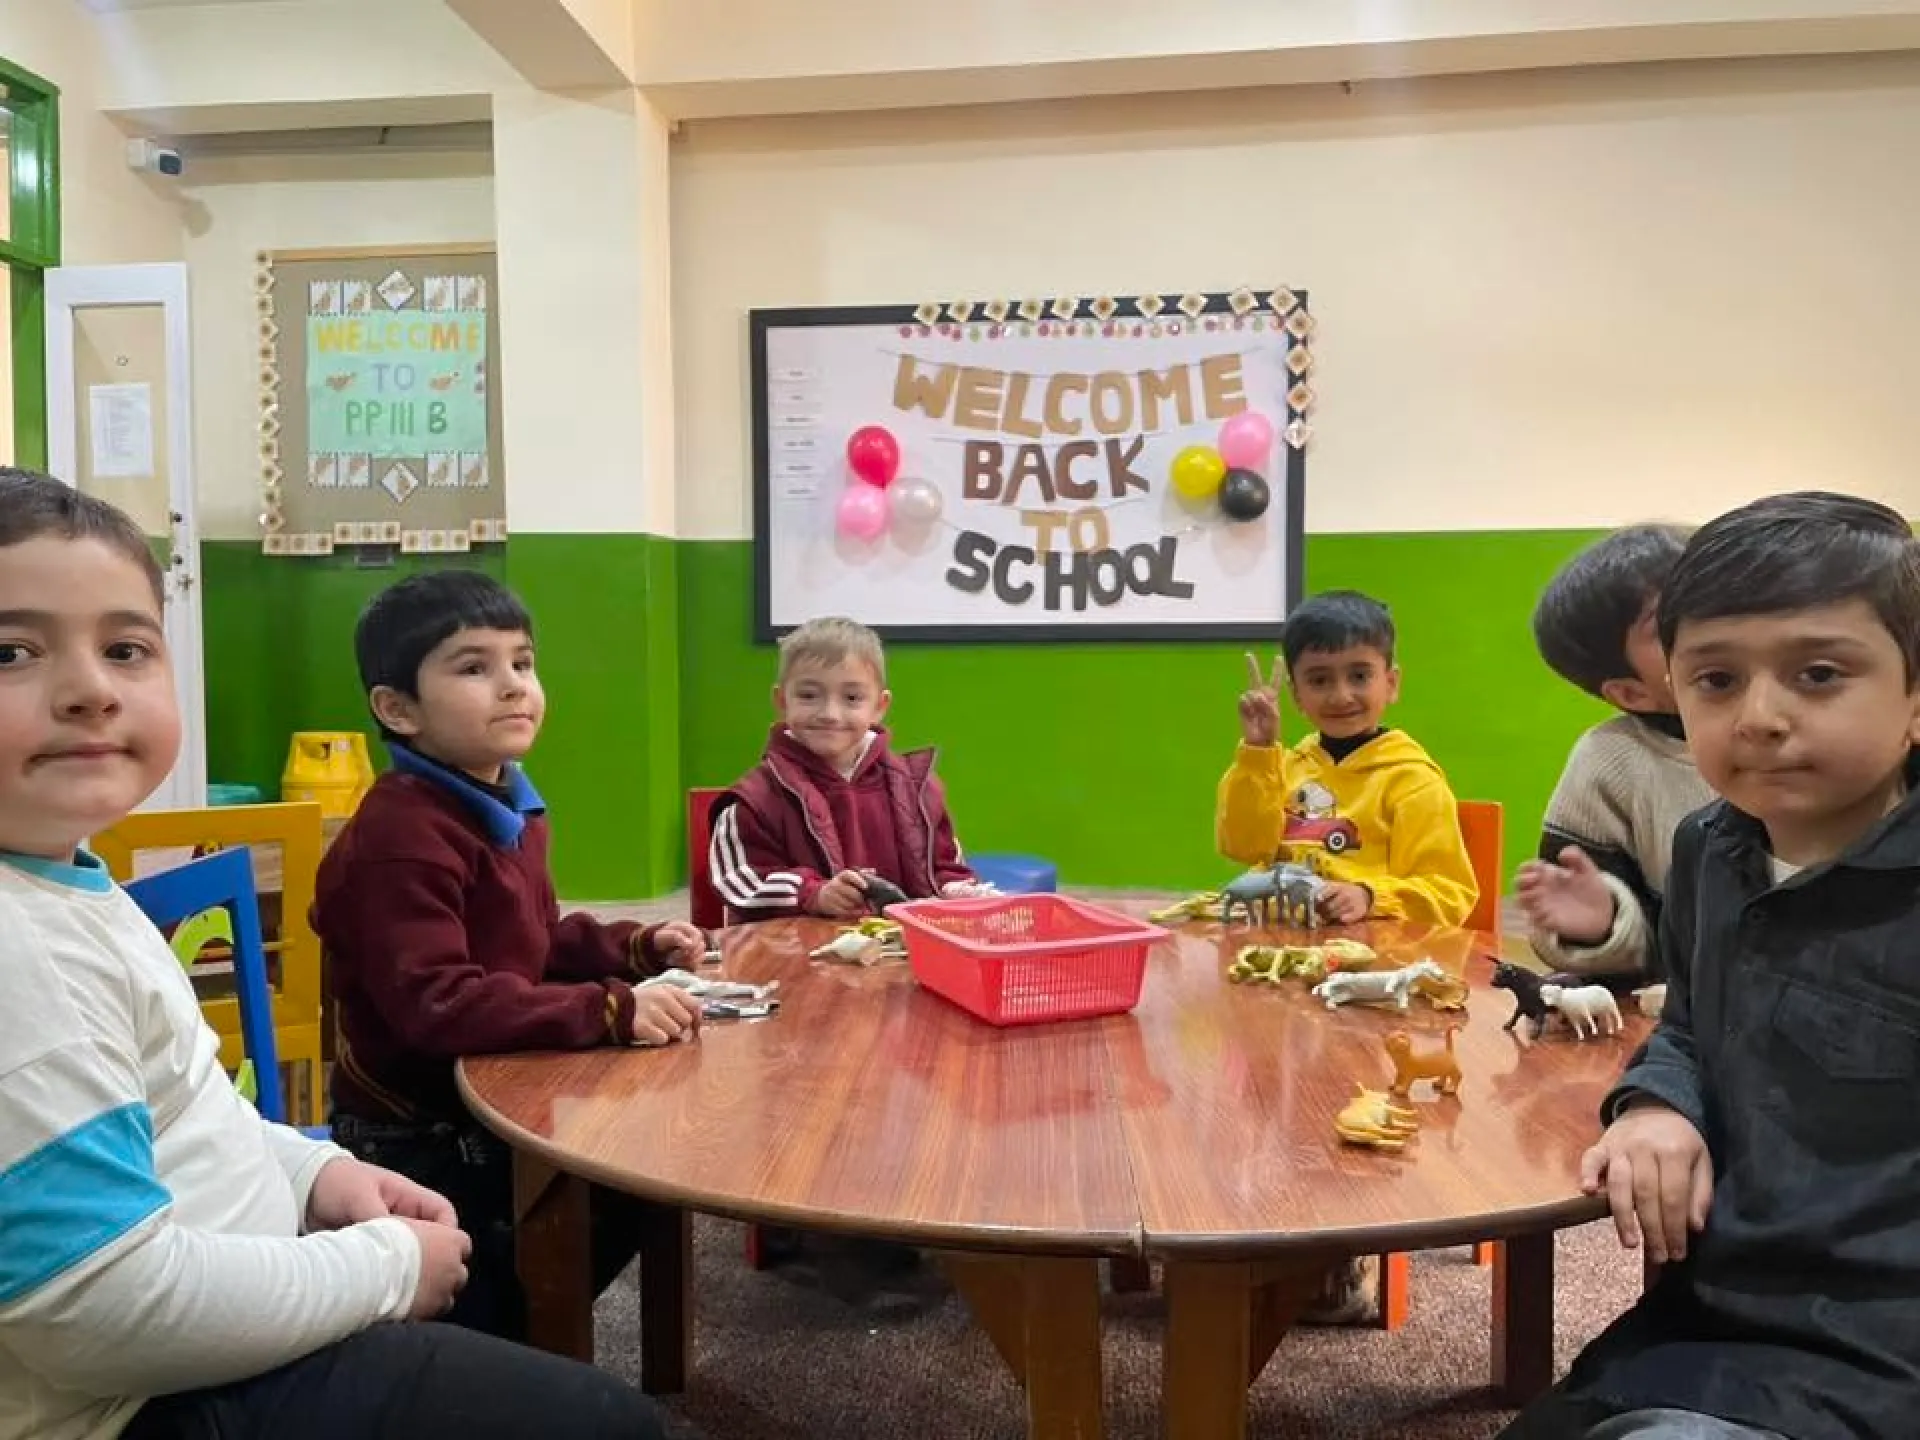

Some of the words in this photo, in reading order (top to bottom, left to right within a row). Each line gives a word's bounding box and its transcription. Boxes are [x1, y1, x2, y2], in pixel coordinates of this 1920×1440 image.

[316, 321, 480, 352] WELCOME
[372, 363, 415, 392] TO
[894, 353, 1247, 437] WELCOME
[429, 401, 447, 434] B
[963, 435, 1150, 504] BACK
[1022, 509, 1110, 564] TO
[946, 531, 1194, 610] SCHOOL
